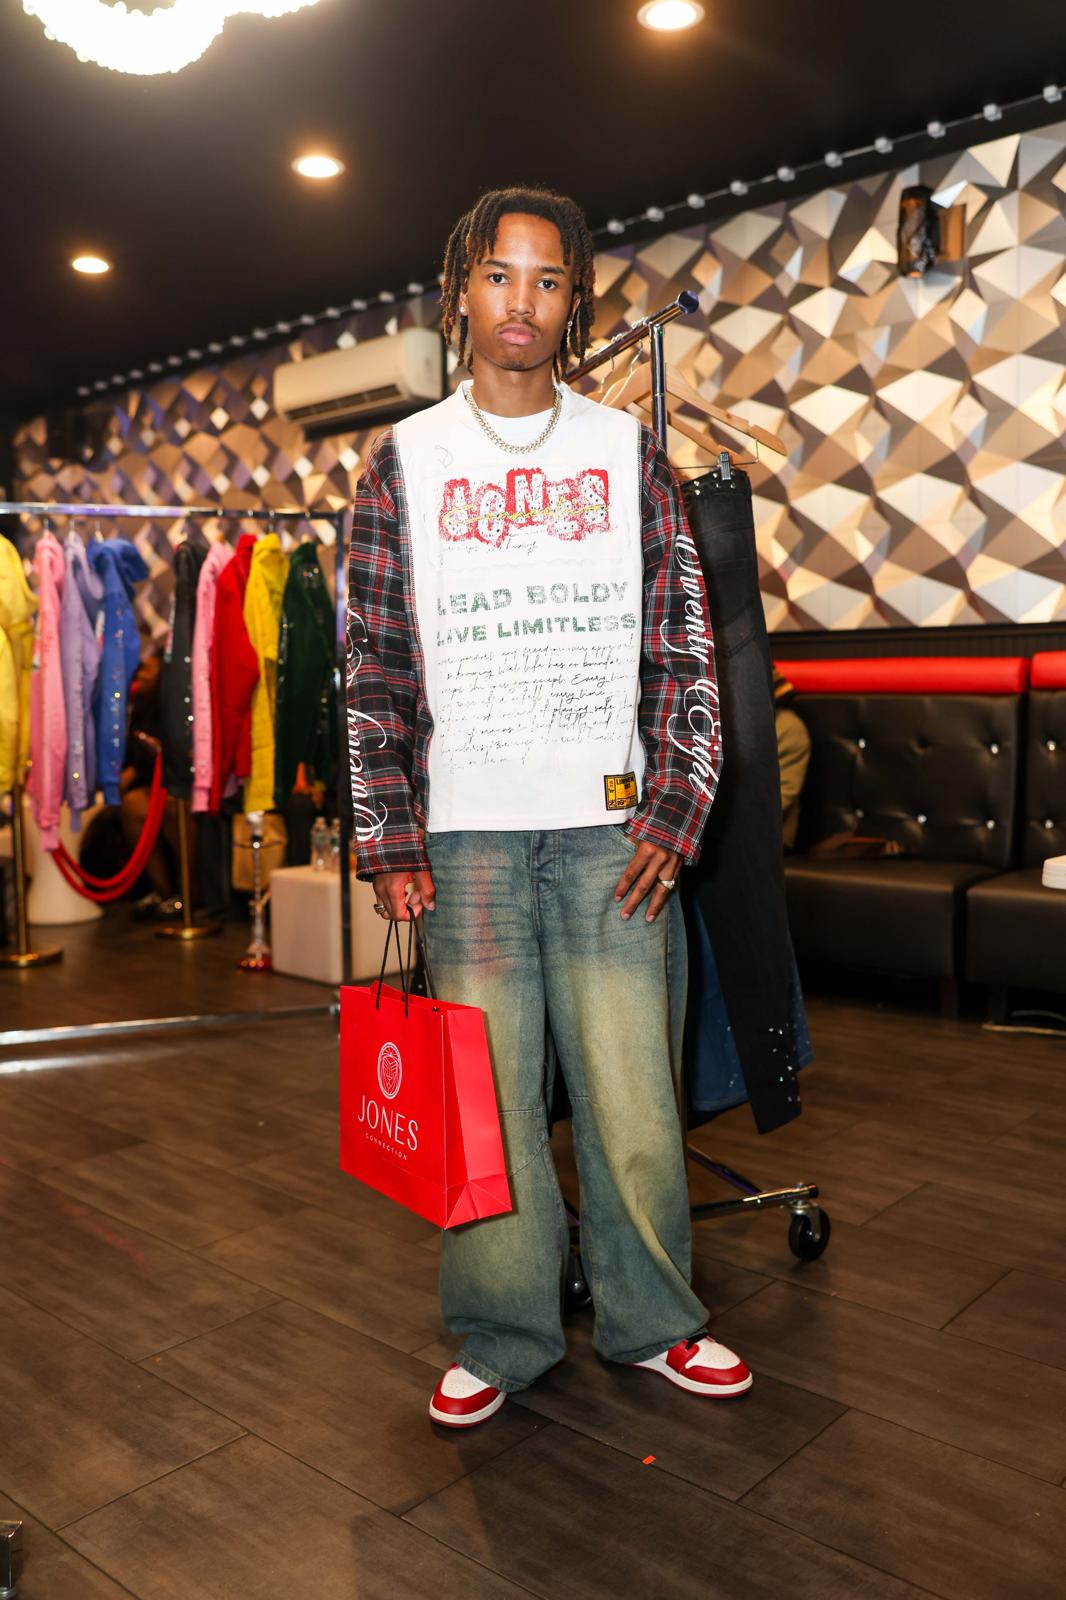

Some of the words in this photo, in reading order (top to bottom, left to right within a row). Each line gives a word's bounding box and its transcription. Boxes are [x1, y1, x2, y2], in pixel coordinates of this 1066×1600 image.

[440, 470, 608, 542] JONES
[436, 588, 513, 616] LEAD
[526, 581, 629, 604] BOLDY
[660, 533, 715, 666] Twenty
[436, 624, 488, 647] LIVE
[497, 613, 637, 639] LIMITLESS
[666, 677, 723, 803] Eight
[357, 1095, 419, 1152] JONES
[365, 1131, 409, 1161] CONNECTION
